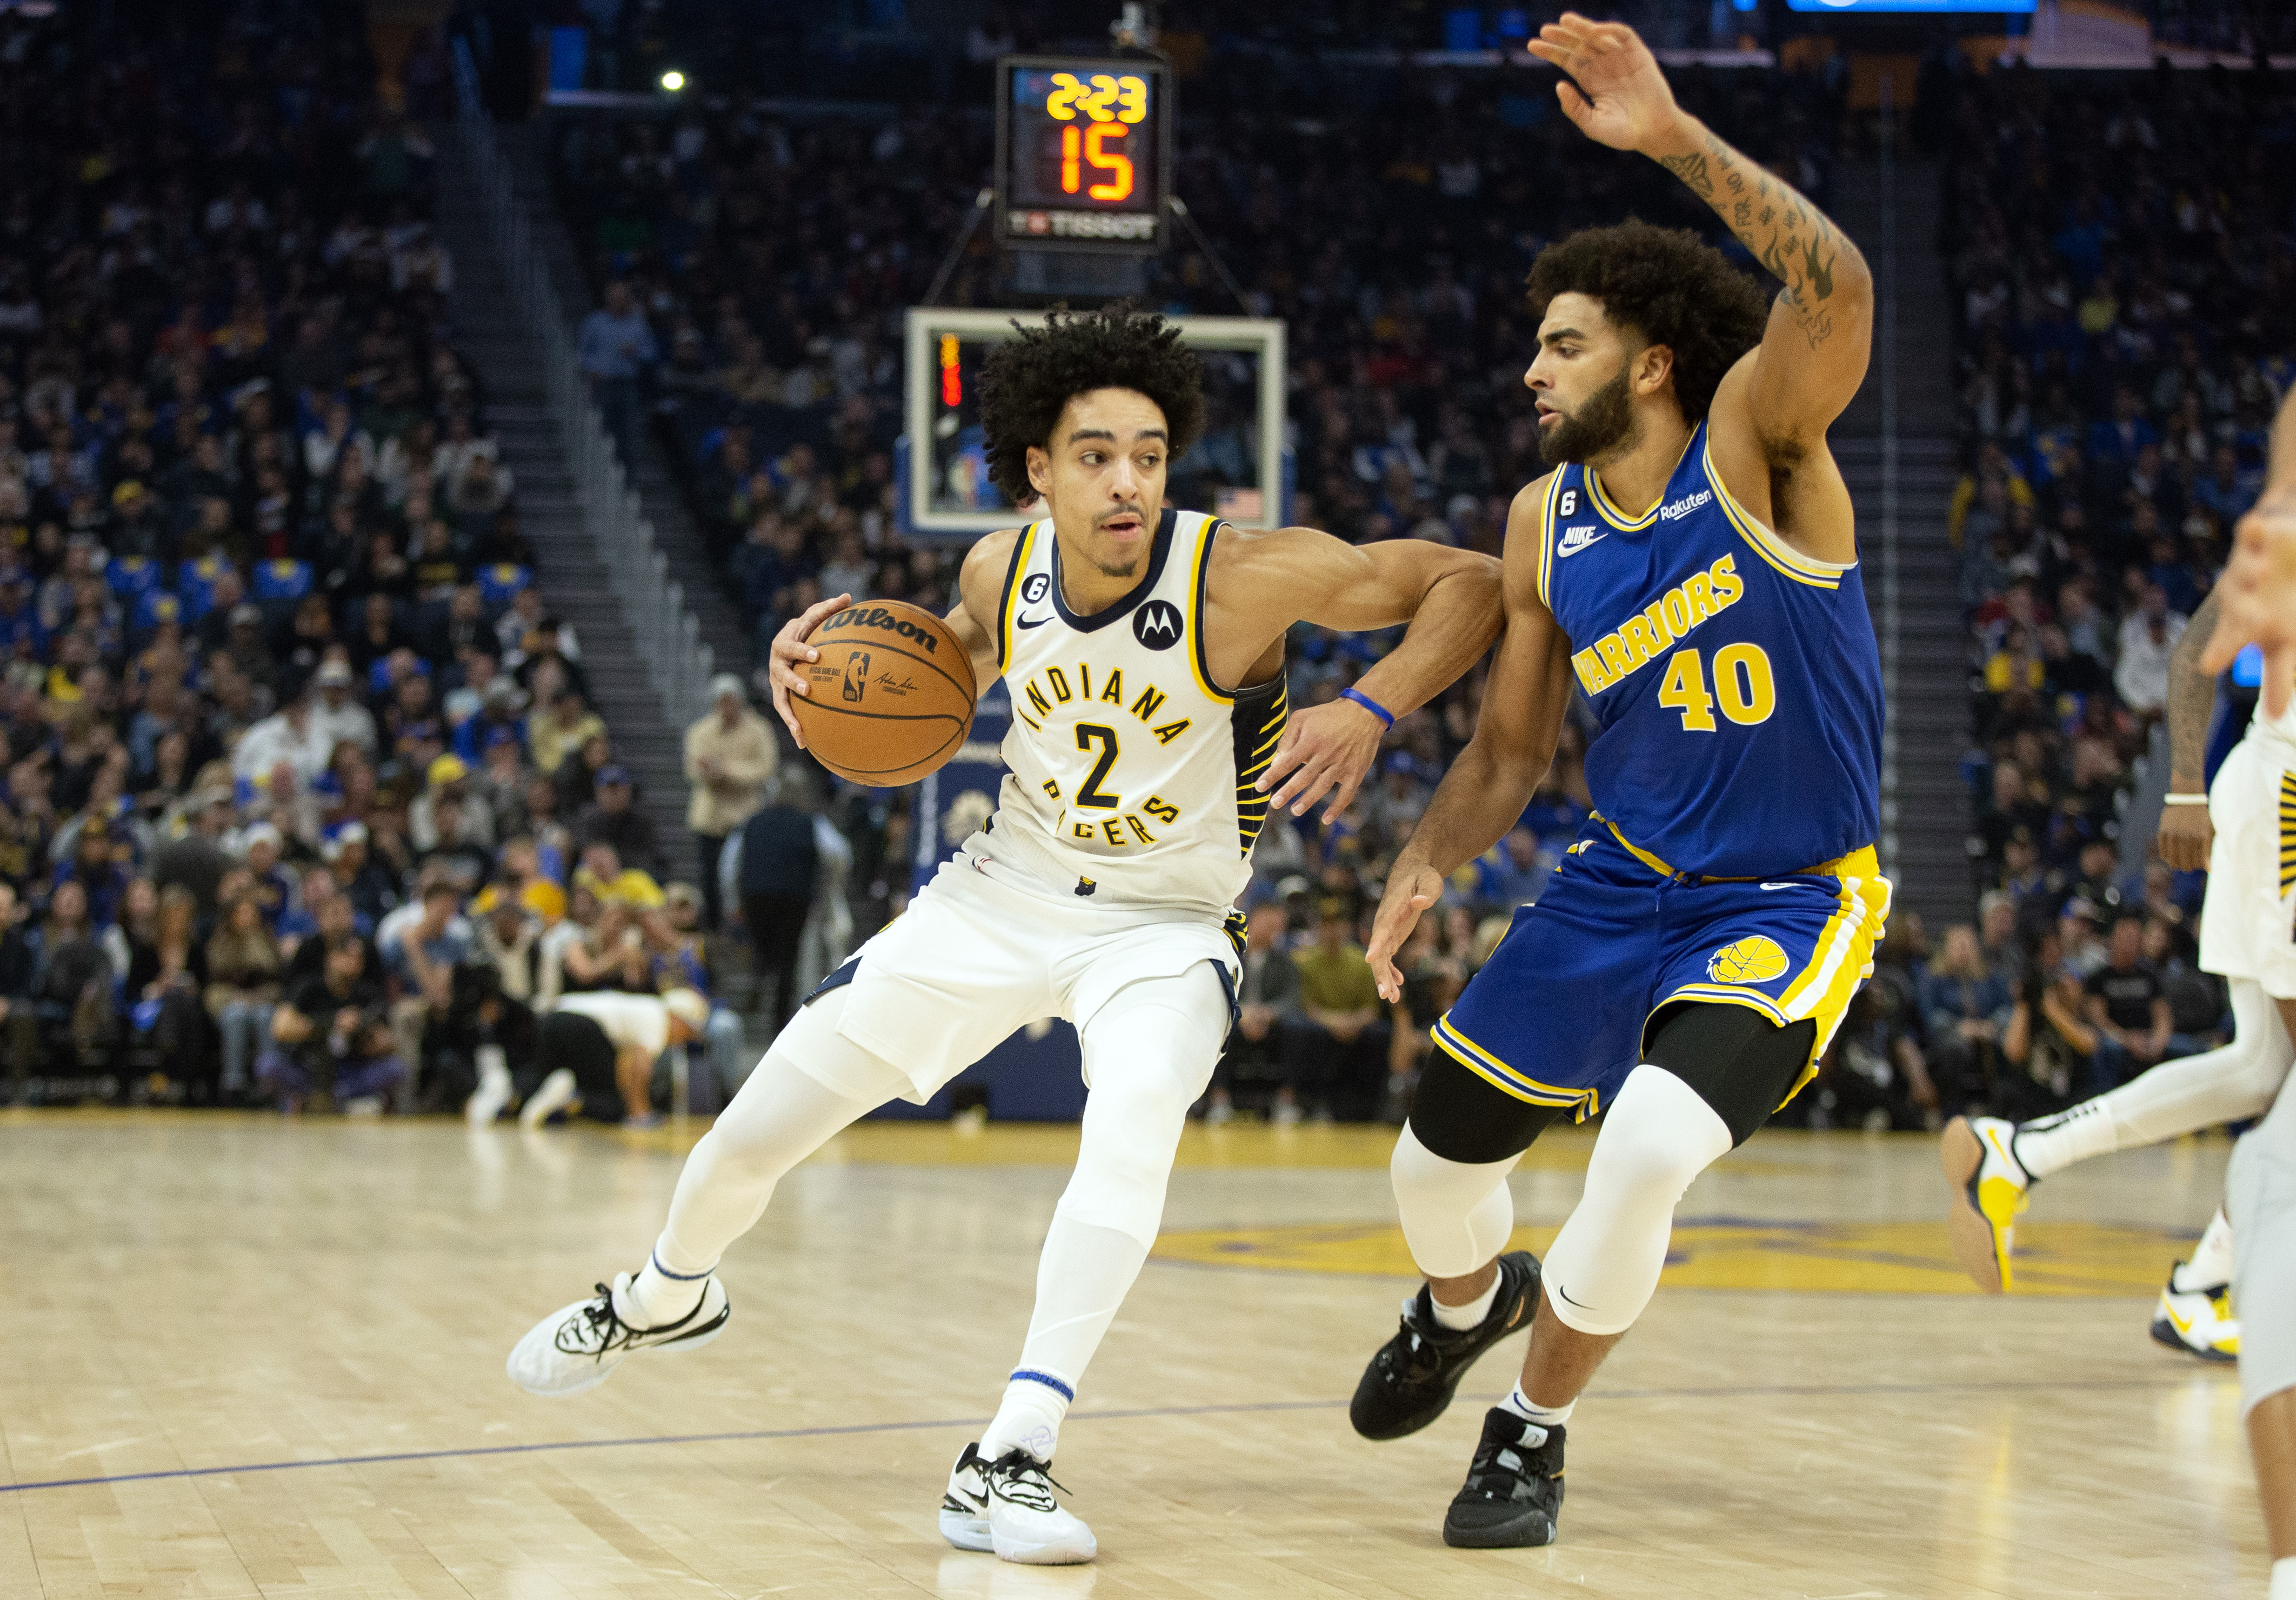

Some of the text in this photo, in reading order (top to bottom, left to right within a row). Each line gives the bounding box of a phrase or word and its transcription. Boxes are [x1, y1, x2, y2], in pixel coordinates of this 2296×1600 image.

[1047, 73, 1147, 123] 2:23
[1062, 122, 1133, 201] 15
[1053, 210, 1153, 239] TISSOT
[1559, 490, 1576, 517] 6
[1660, 489, 1712, 520] Rakuten
[1564, 525, 1597, 545] NIKE
[1027, 577, 1047, 601] 6
[822, 608, 938, 655] Wilson
[1570, 552, 1744, 697] WARRIORS
[1018, 662, 1192, 747] INDIANA
[1658, 642, 1776, 732] 40
[1074, 722, 1121, 811] 2
[1042, 777, 1182, 847] PCERS
